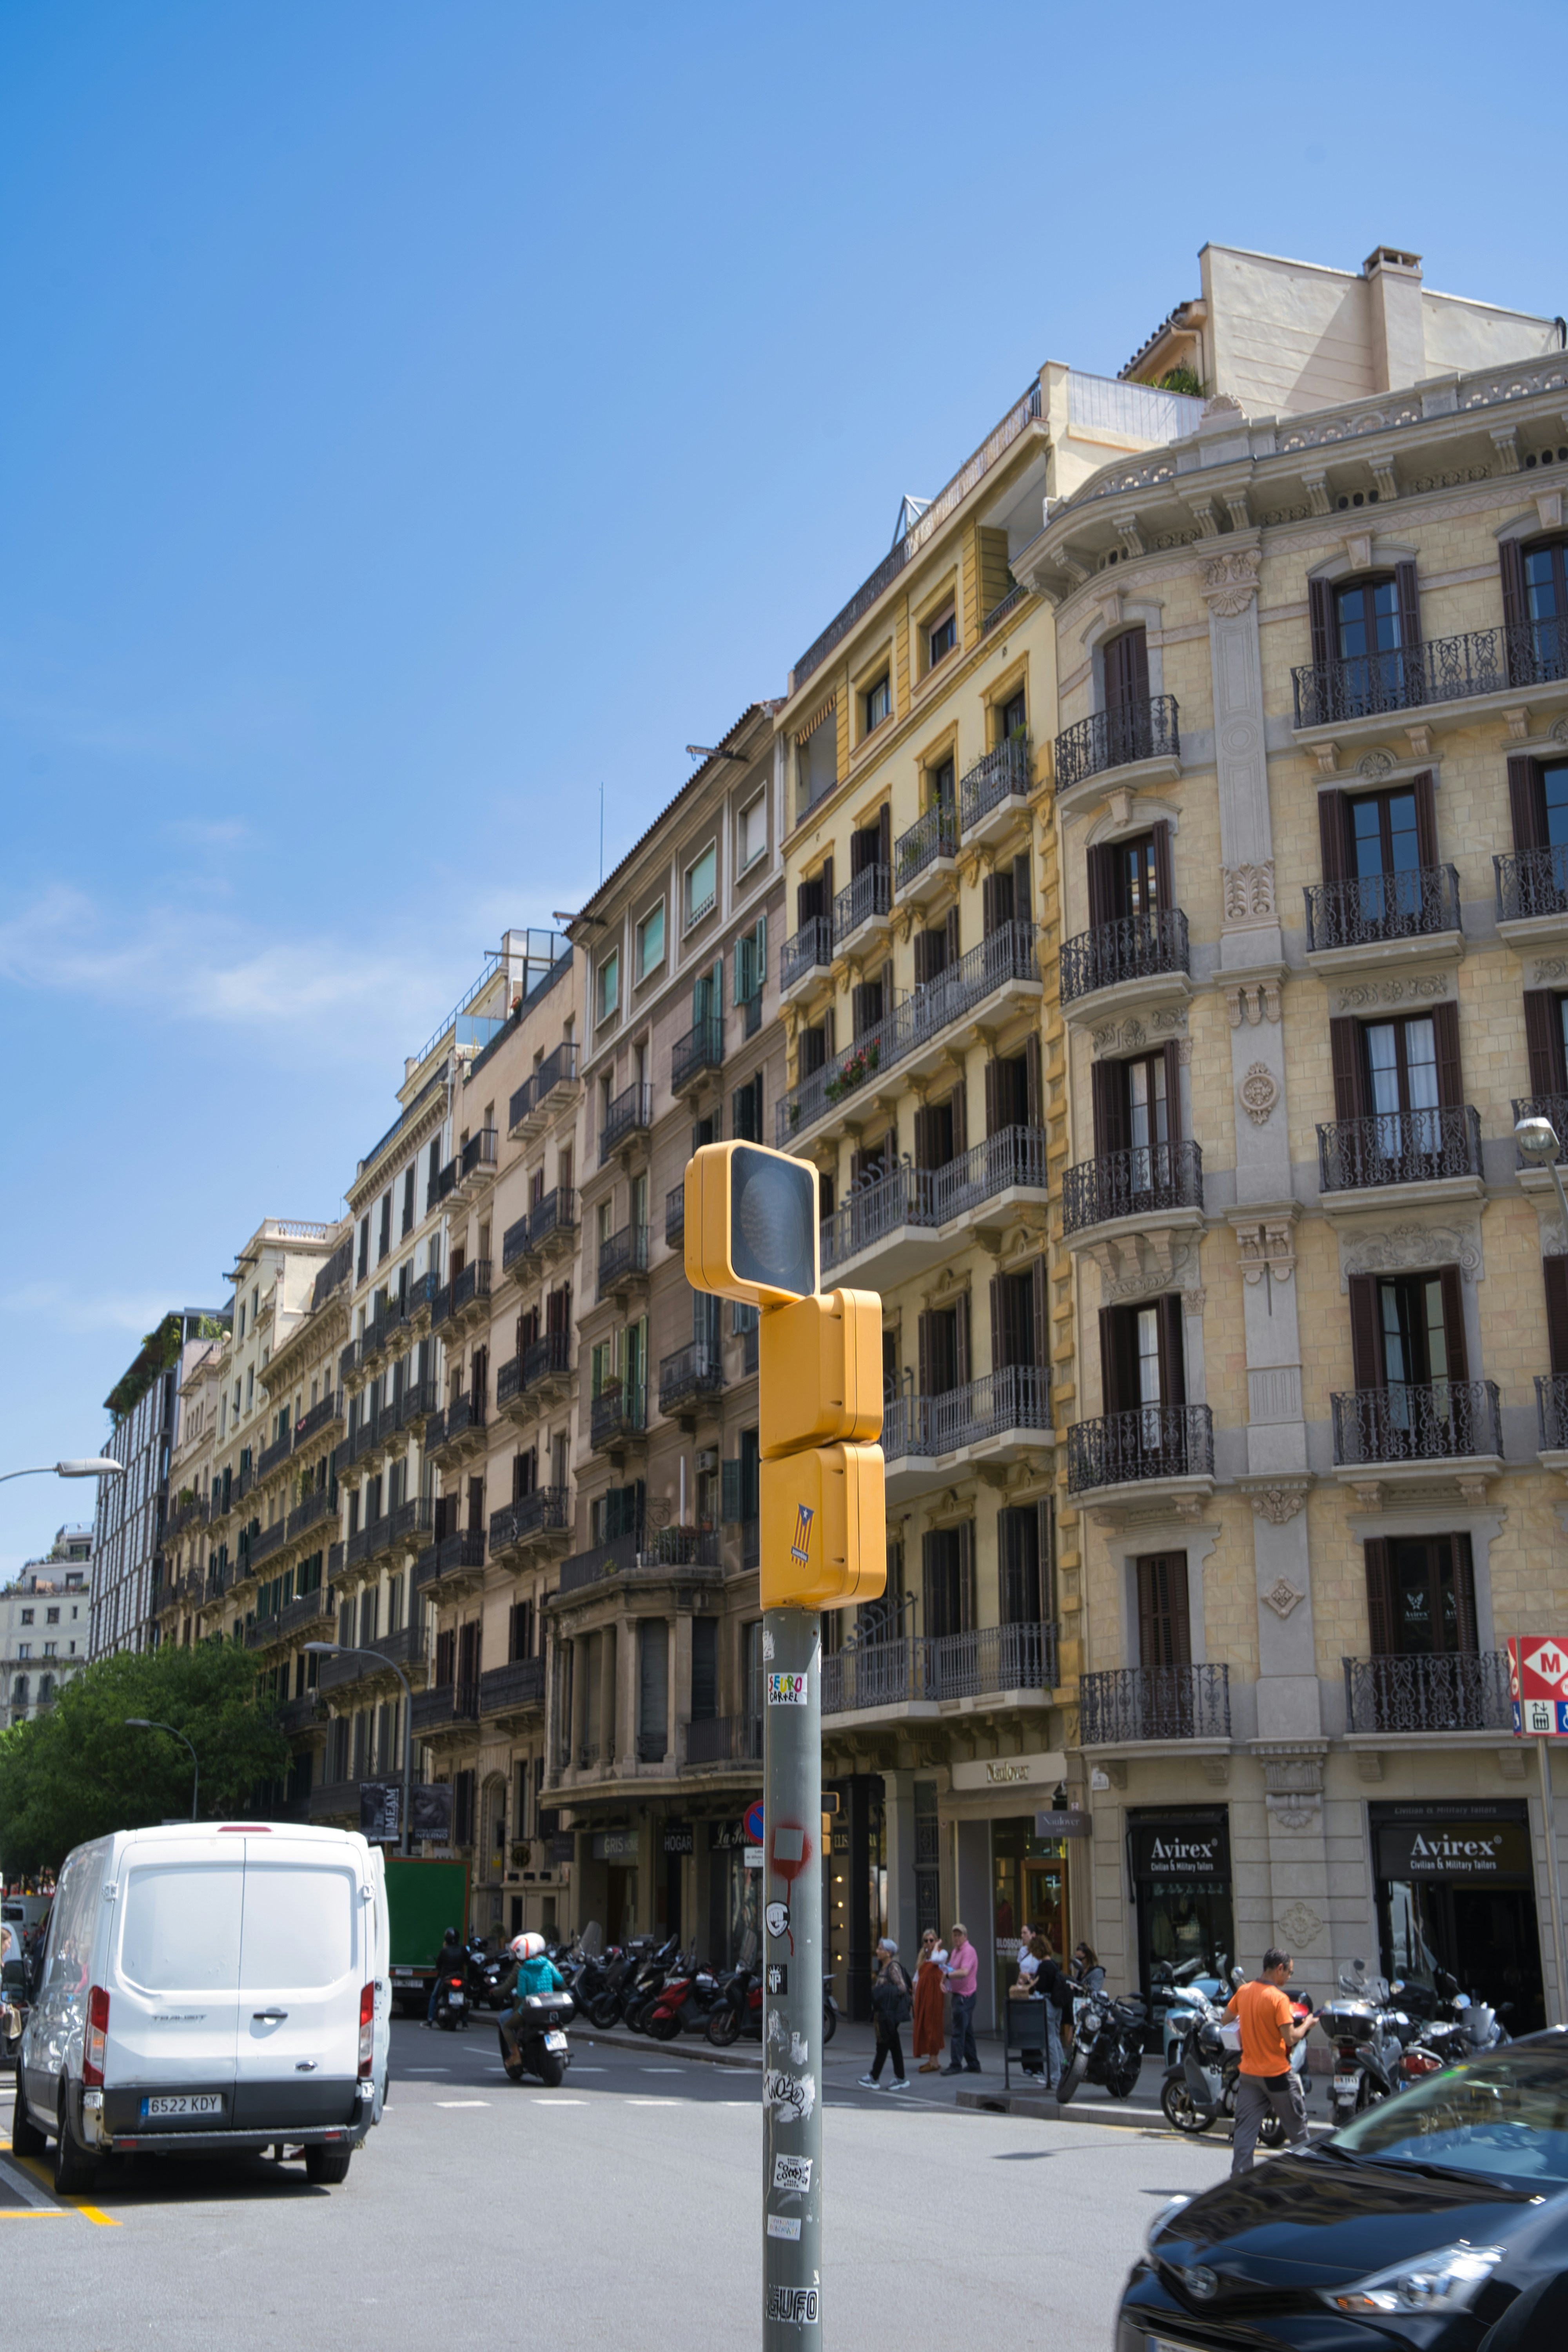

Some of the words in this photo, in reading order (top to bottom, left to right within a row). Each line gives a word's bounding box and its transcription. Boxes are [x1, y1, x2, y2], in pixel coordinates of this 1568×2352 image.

[1541, 1653, 1561, 1673] M
[769, 1674, 802, 1693] SEURO
[986, 1762, 1030, 1783] Naulover
[385, 1788, 396, 1829] MEAM
[1043, 1816, 1081, 1826] Naulover
[604, 1837, 624, 1853] GRIS
[664, 1835, 692, 1851] HOGAR
[1151, 1862, 1169, 1871] Civilian
[1170, 1859, 1175, 1871] &
[1176, 1862, 1196, 1873] Military
[1197, 1862, 1214, 1871] Tailors
[1410, 1860, 1436, 1869] Civilian
[1437, 1857, 1444, 1869] &
[1446, 1860, 1472, 1872] Military
[1473, 1860, 1497, 1869] Tailors
[996, 1937, 1023, 1949] BLOSSOM
[151, 2098, 186, 2113] 6522
[191, 2096, 218, 2111] KDY
